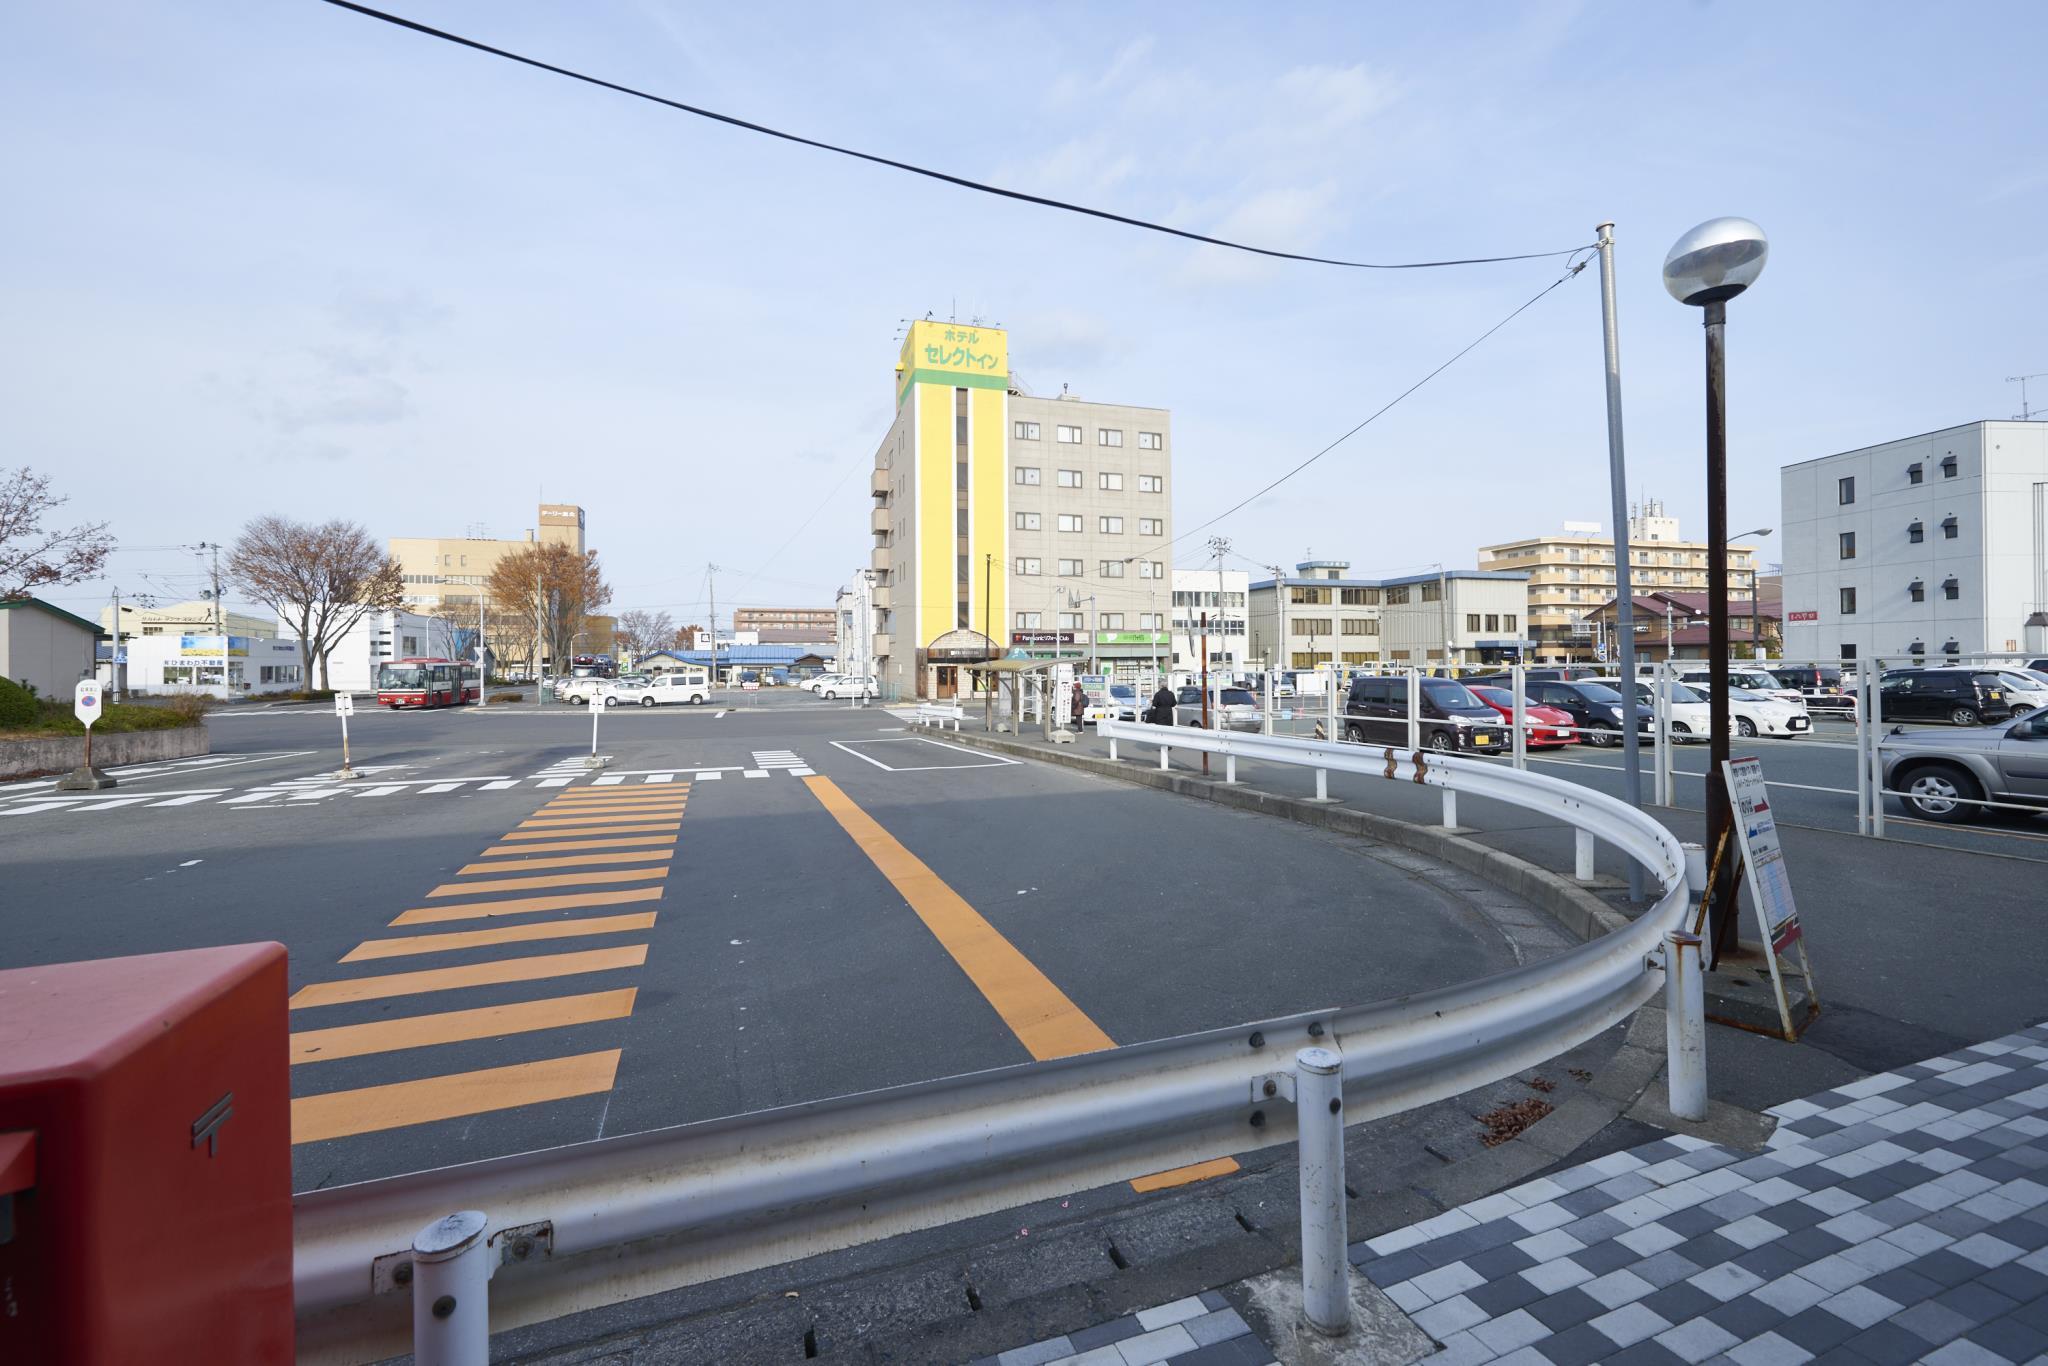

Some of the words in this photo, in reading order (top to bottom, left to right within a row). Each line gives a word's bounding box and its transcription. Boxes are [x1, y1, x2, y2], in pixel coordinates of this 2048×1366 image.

[945, 329, 979, 344] ホテル
[924, 343, 999, 370] セレクトイン
